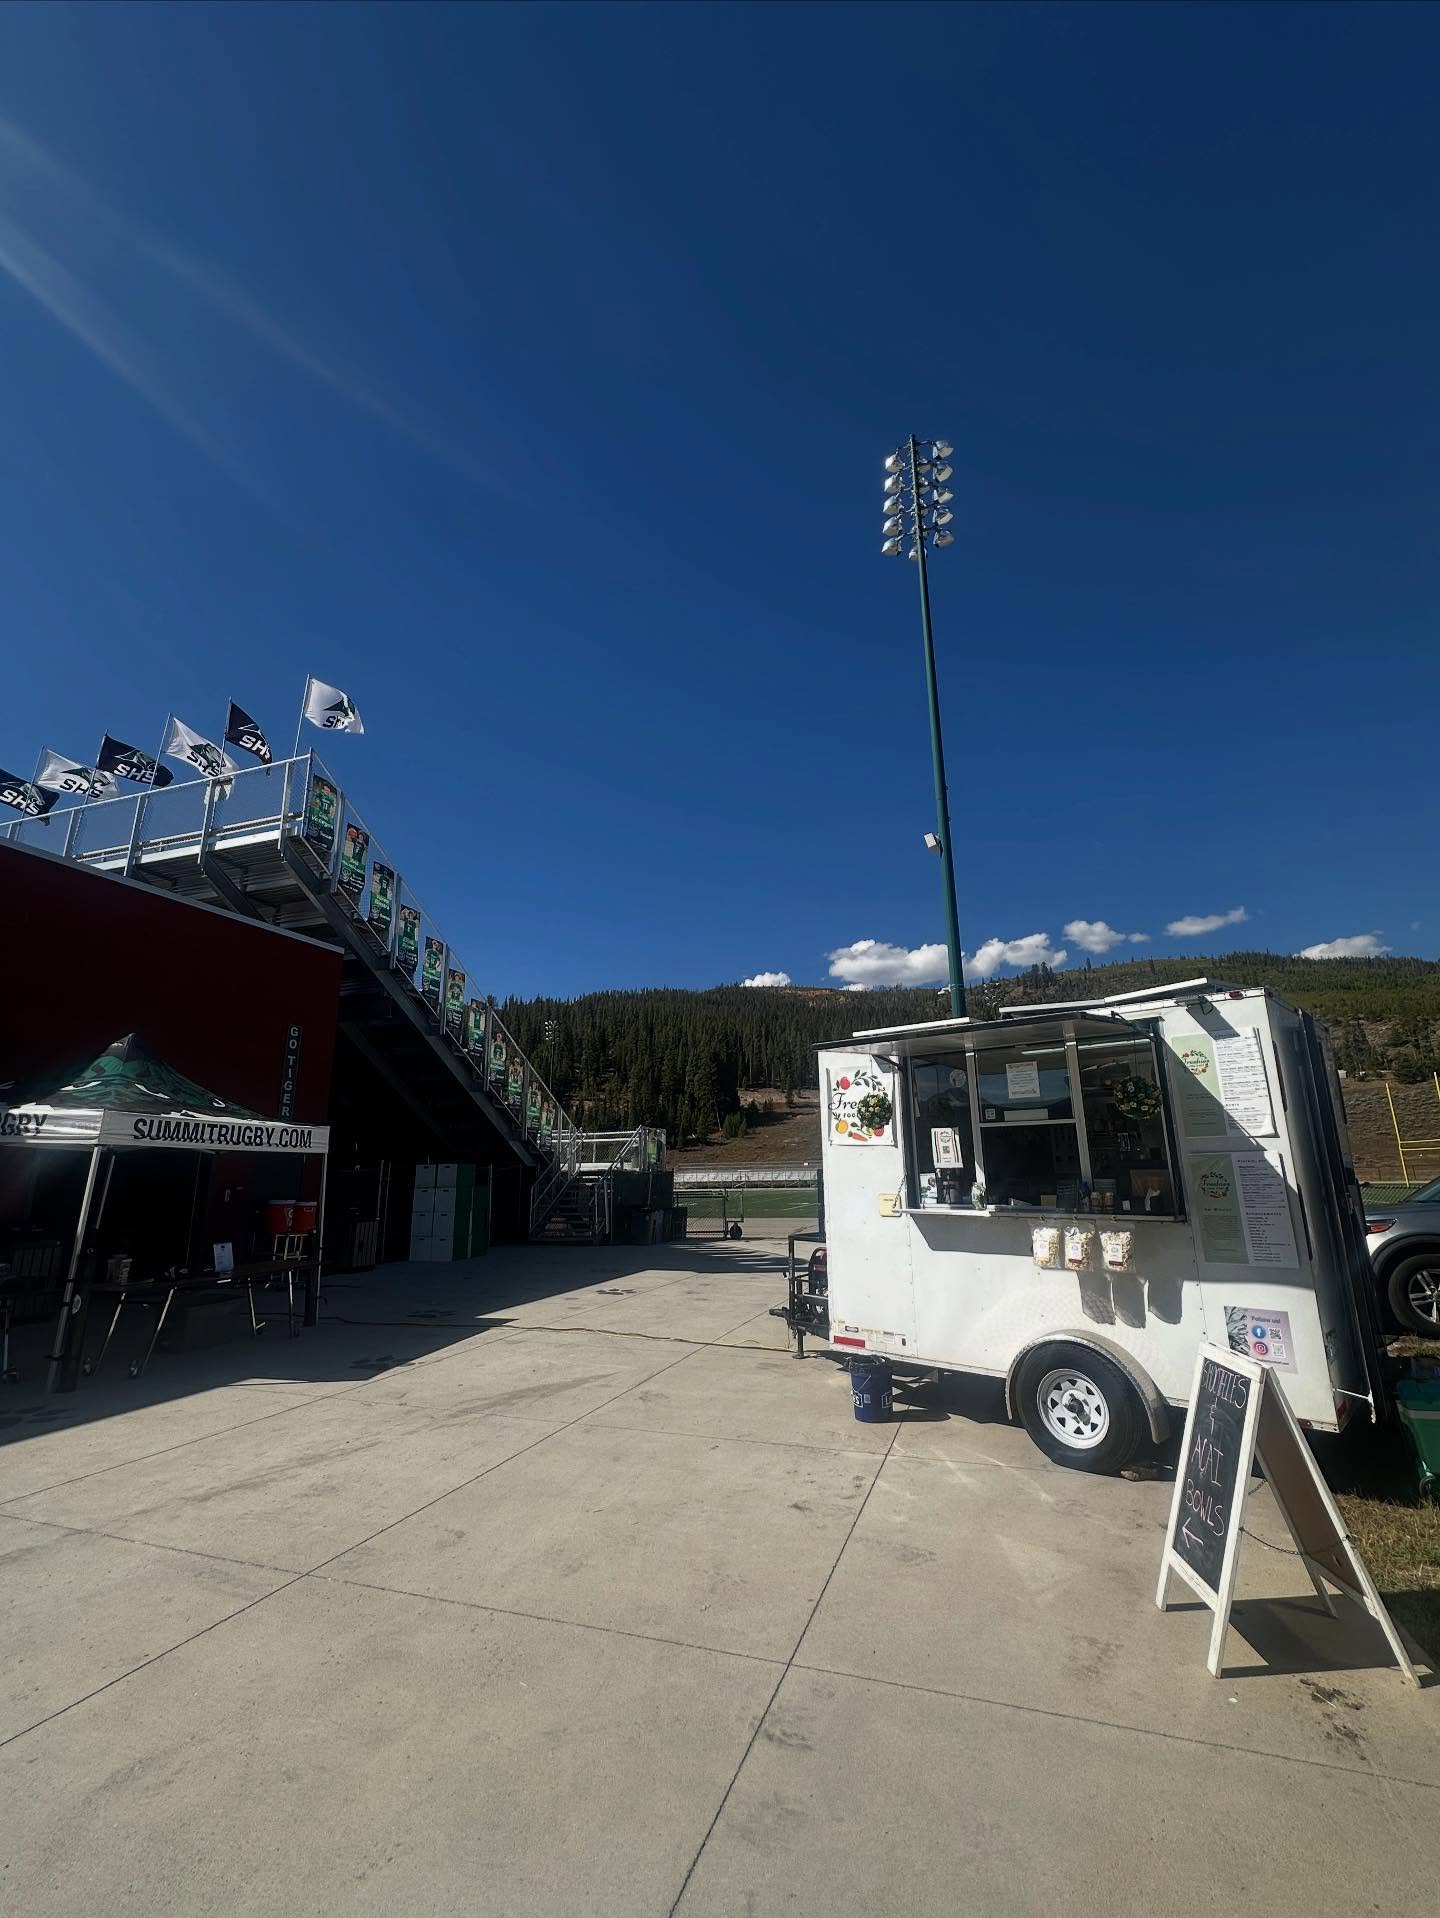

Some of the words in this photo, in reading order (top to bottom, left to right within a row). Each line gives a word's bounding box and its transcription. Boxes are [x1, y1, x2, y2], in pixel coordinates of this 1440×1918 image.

[113, 763, 157, 784] SHS
[60, 778, 104, 799] SHS
[0, 789, 40, 815] SHS
[289, 1026, 299, 1049] GO
[281, 1055, 297, 1117] TIGER
[828, 1092, 858, 1111] Fre
[0, 1112, 48, 1136] GBY
[133, 1117, 312, 1149] SUMMITRUGBY.COM
[1191, 1434, 1224, 1487] ACAI
[1186, 1479, 1225, 1536] BOWLS
